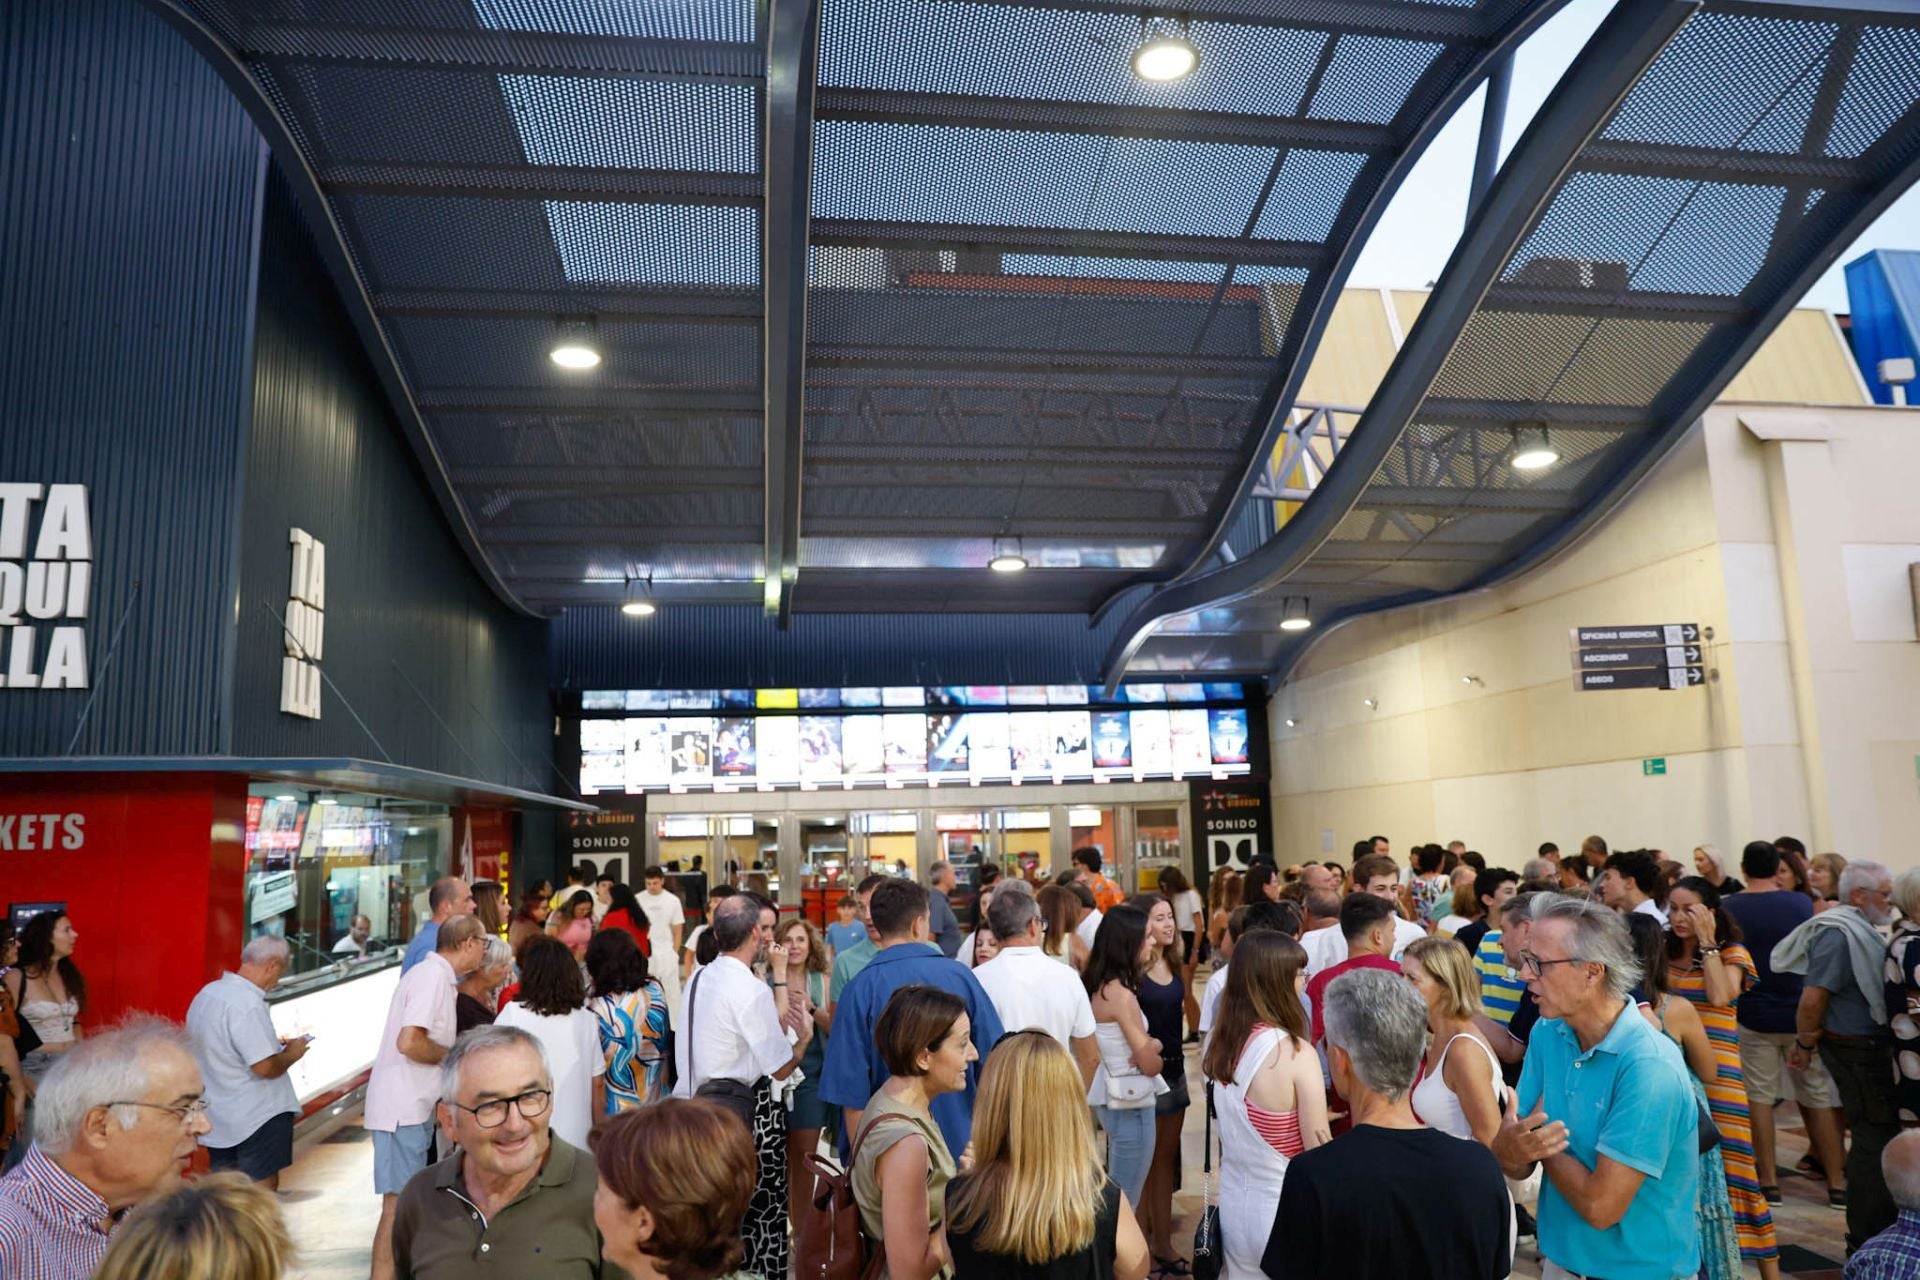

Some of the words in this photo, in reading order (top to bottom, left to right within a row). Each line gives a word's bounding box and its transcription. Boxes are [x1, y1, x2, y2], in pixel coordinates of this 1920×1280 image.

[0, 482, 91, 560] TA
[290, 527, 325, 612] TA
[285, 598, 325, 661] QUI
[1583, 653, 1629, 663] ASCENSOR
[280, 656, 322, 720] LLA
[1585, 675, 1615, 684] ASEOS
[572, 835, 631, 849] SONIDO
[1206, 818, 1258, 831] SONIDO
